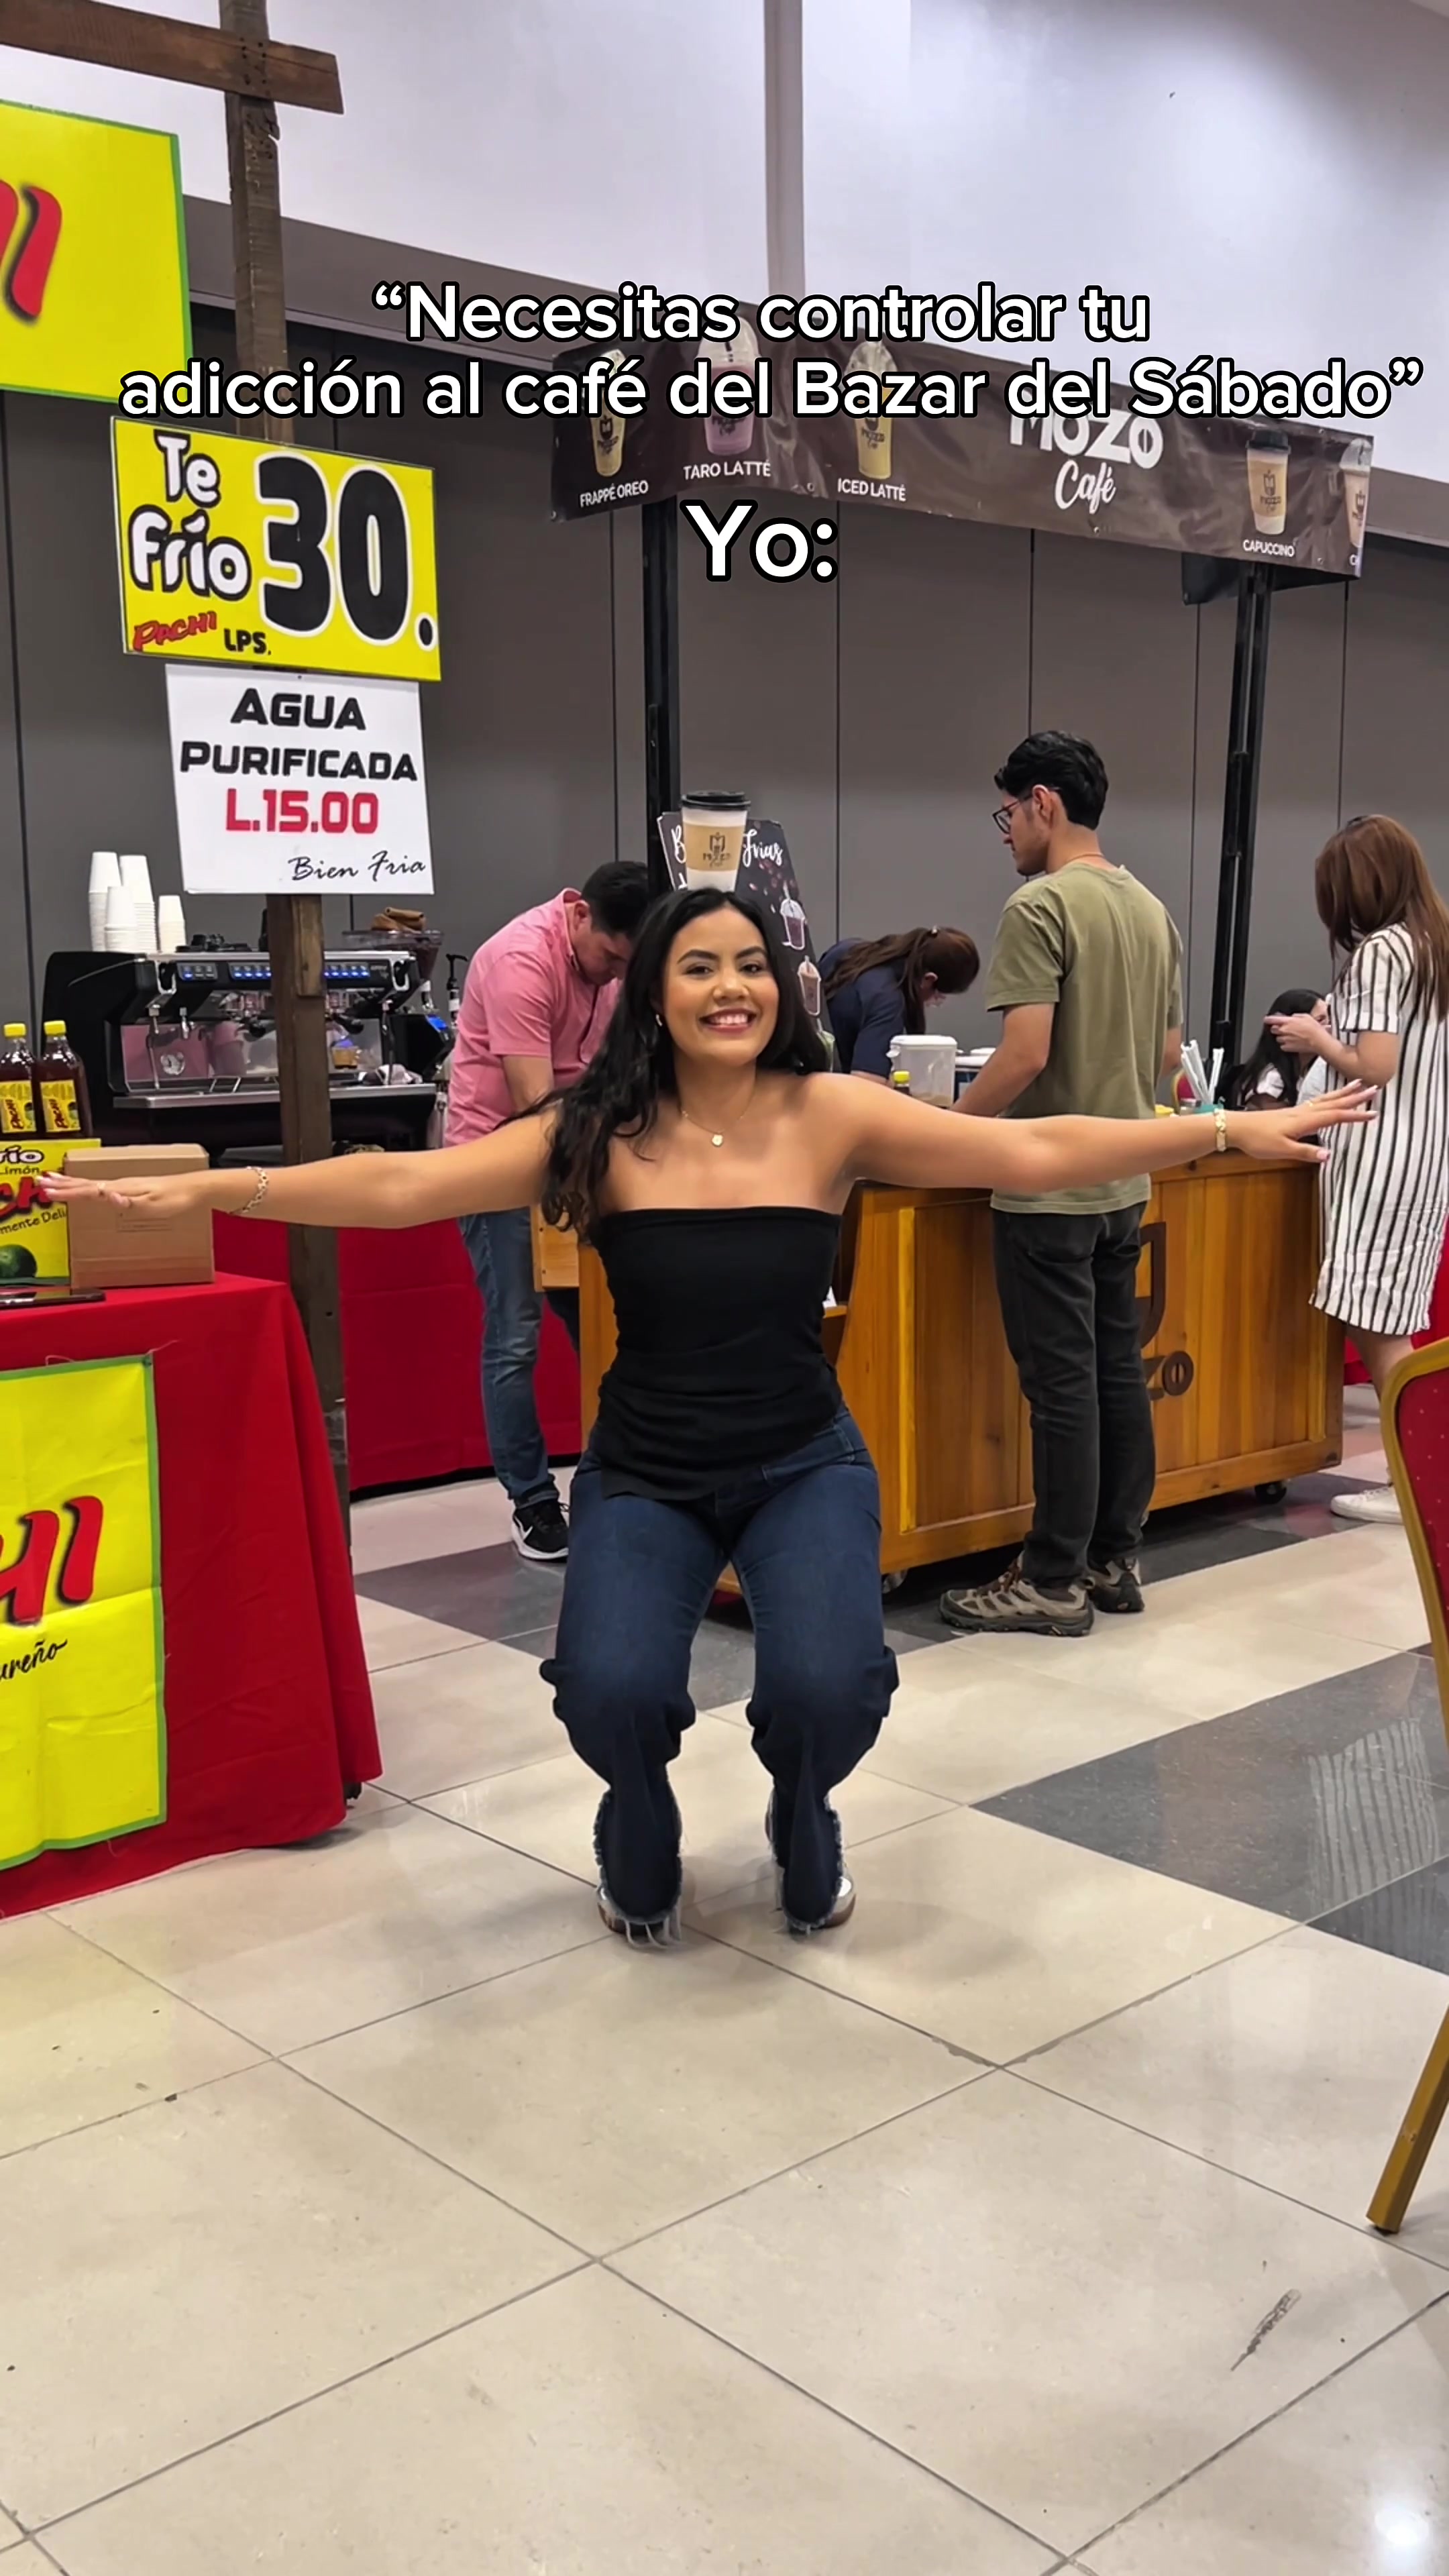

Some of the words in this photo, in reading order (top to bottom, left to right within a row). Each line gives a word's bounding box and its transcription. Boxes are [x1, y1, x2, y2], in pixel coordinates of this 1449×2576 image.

[153, 429, 221, 508] Te
[683, 463, 721, 480] TARO
[837, 477, 869, 496] ICED
[1055, 460, 1116, 515] Café
[580, 482, 616, 508] FRAPPÉ
[616, 480, 649, 500] OREO
[1242, 539, 1295, 557] CAPUCCINO
[133, 611, 217, 652] PACHI
[230, 688, 366, 731] AGUA
[180, 741, 417, 781] PURIFICADA
[225, 788, 379, 833] L.15.00
[288, 856, 358, 881] Bien
